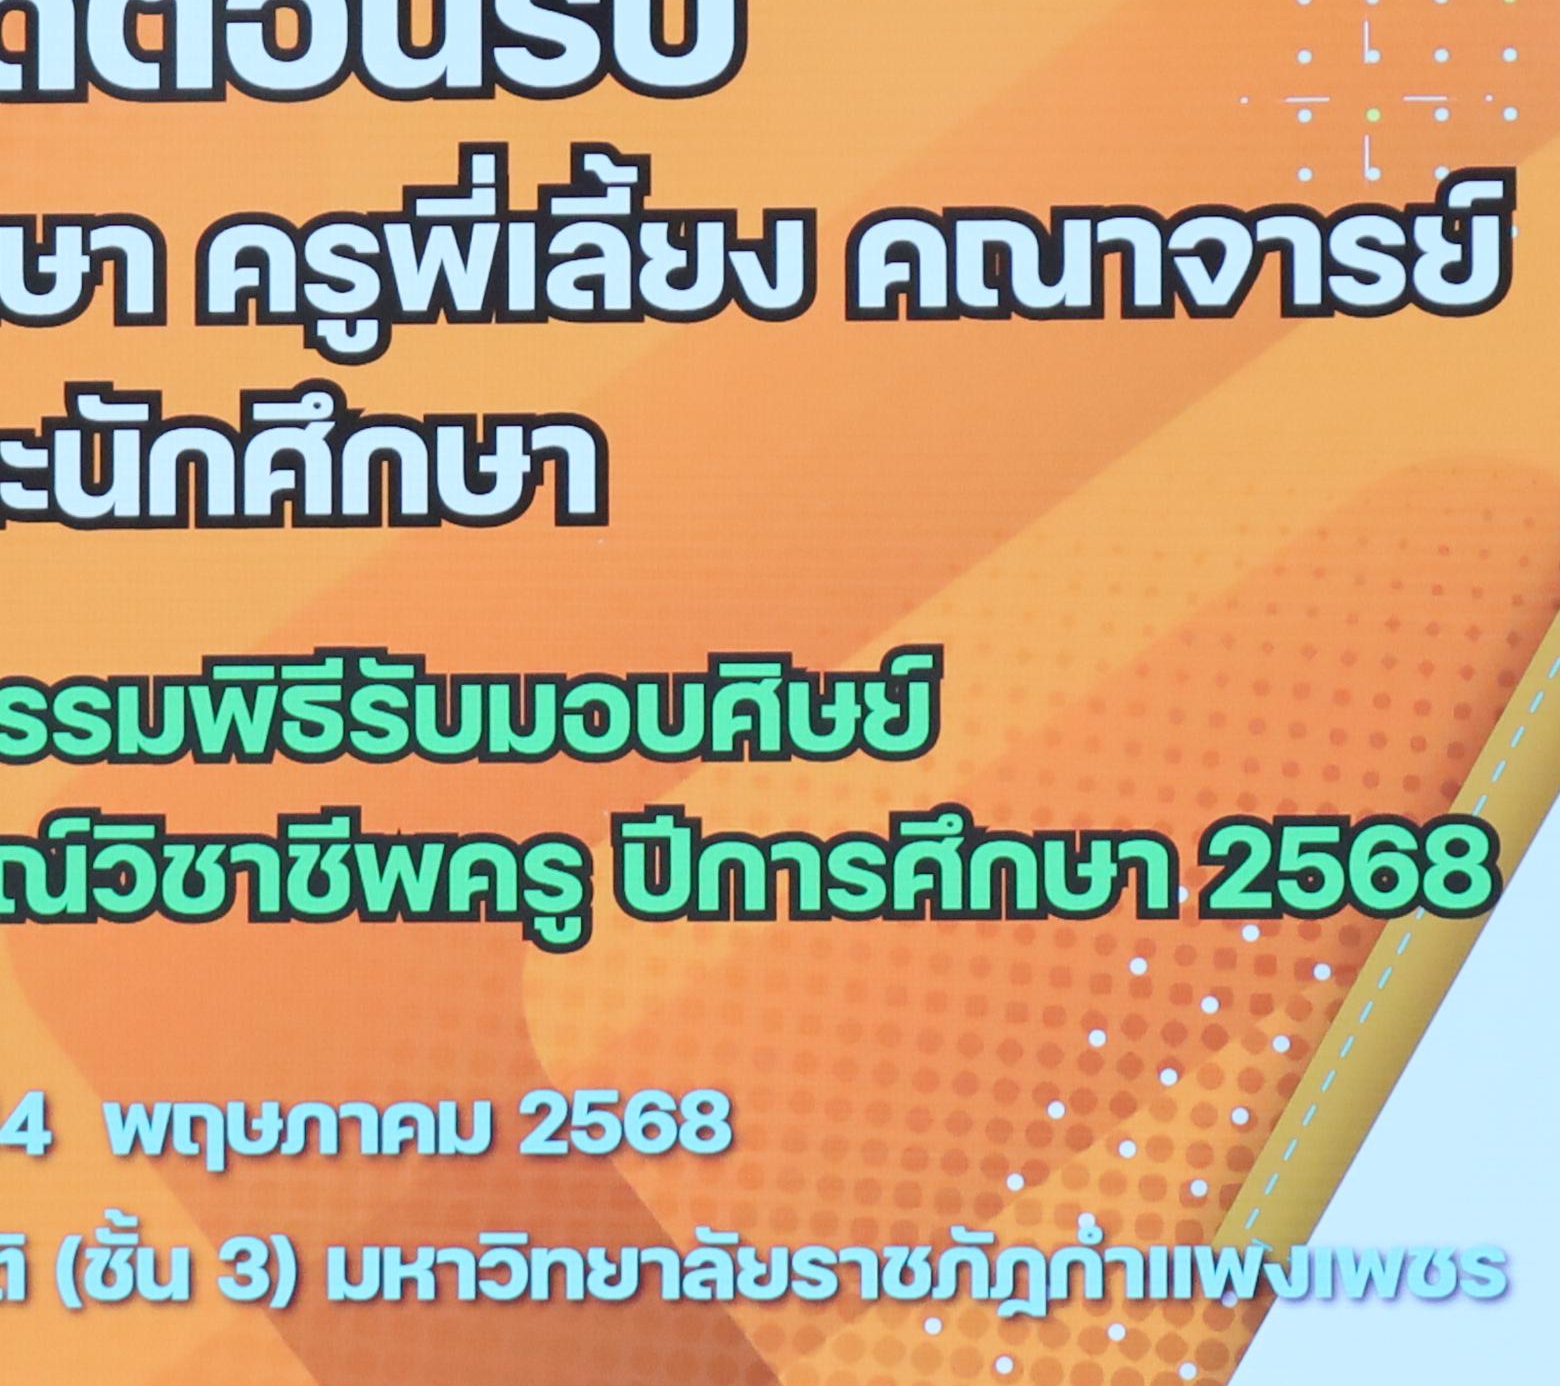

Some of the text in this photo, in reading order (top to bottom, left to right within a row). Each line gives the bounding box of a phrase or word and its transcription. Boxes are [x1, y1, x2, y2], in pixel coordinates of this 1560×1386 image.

[200, 148, 812, 361] ครูพี่เลี้ยง
[851, 173, 1511, 316] คณาจารย์
[615, 807, 1176, 919] ปีการศึกษา
[1202, 817, 1500, 917] 2568
[102, 1091, 492, 1173] พฤษภาคม
[518, 1088, 733, 1155] 2568
[55, 1209, 191, 1310] (ชั้น
[217, 1234, 297, 1309] 3)
